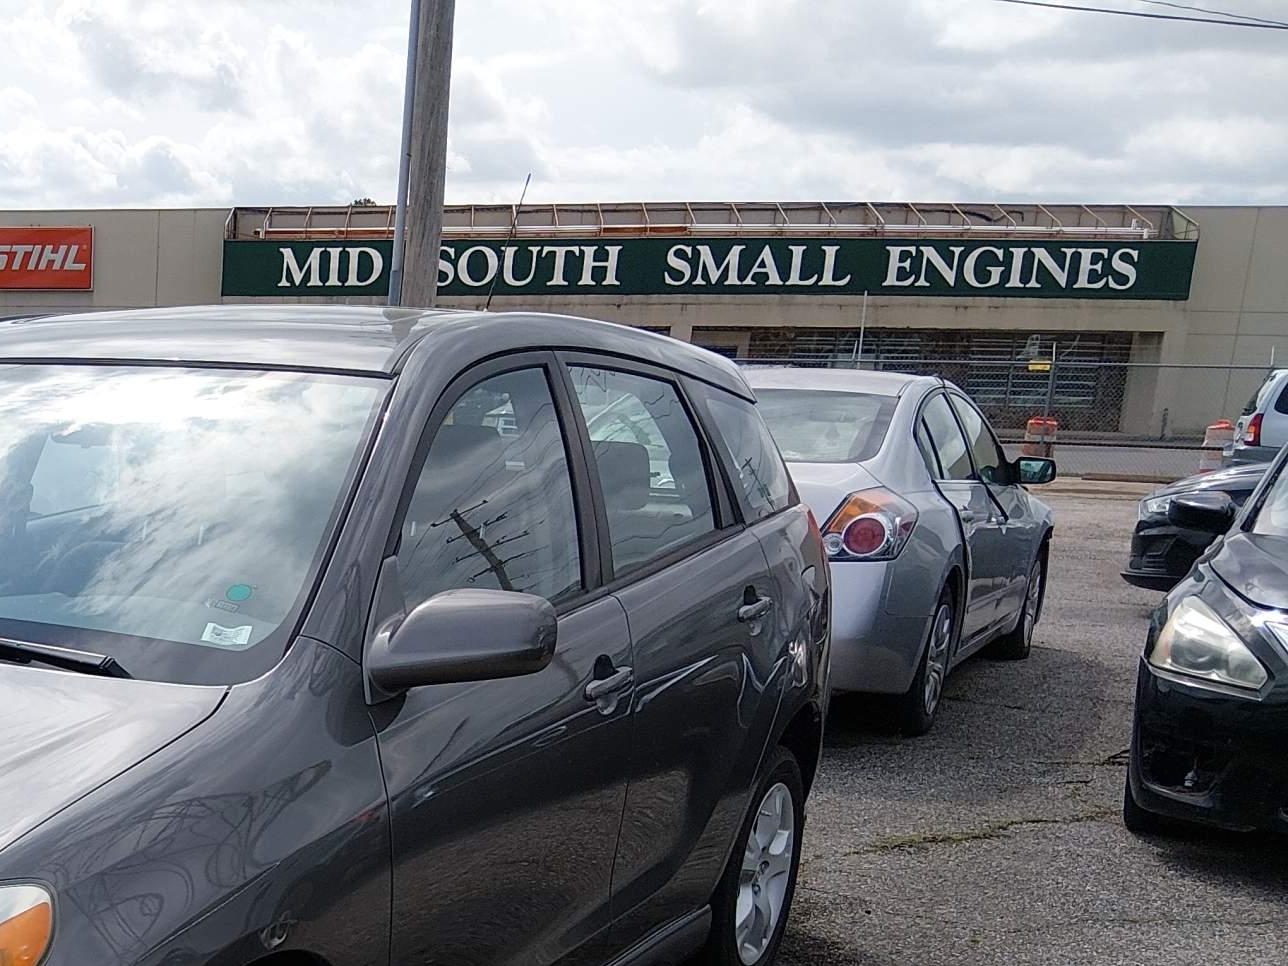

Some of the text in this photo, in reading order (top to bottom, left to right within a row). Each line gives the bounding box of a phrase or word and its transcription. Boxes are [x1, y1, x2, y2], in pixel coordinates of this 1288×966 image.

[277, 244, 1139, 290] MID SOUTH SMALL ENGINES
